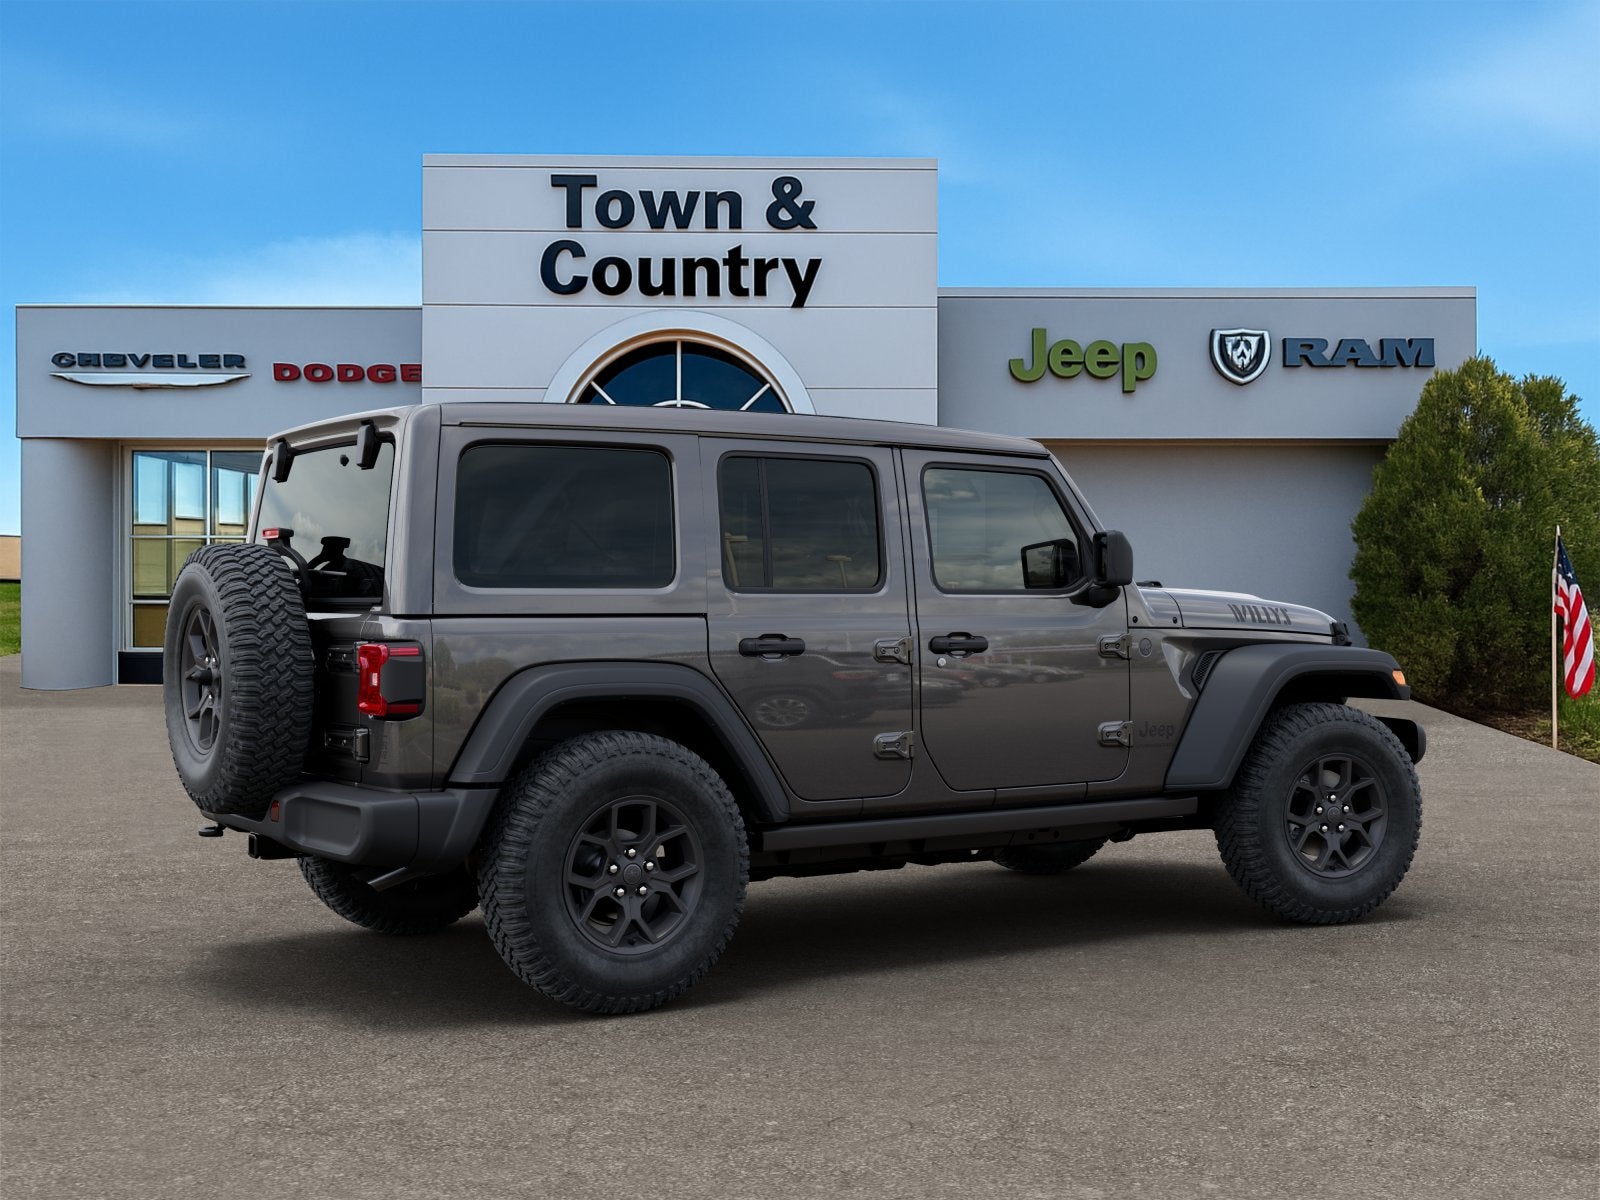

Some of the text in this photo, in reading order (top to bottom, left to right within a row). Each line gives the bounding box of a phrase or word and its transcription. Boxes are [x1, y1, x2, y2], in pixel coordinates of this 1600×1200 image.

[550, 174, 818, 230] Town &
[540, 239, 823, 308] Country
[1008, 328, 1158, 393] Jeep
[1282, 337, 1435, 367] RAM
[272, 362, 423, 383] DODGE
[1227, 603, 1292, 626] WILLYS
[1138, 720, 1176, 740] Jeep
